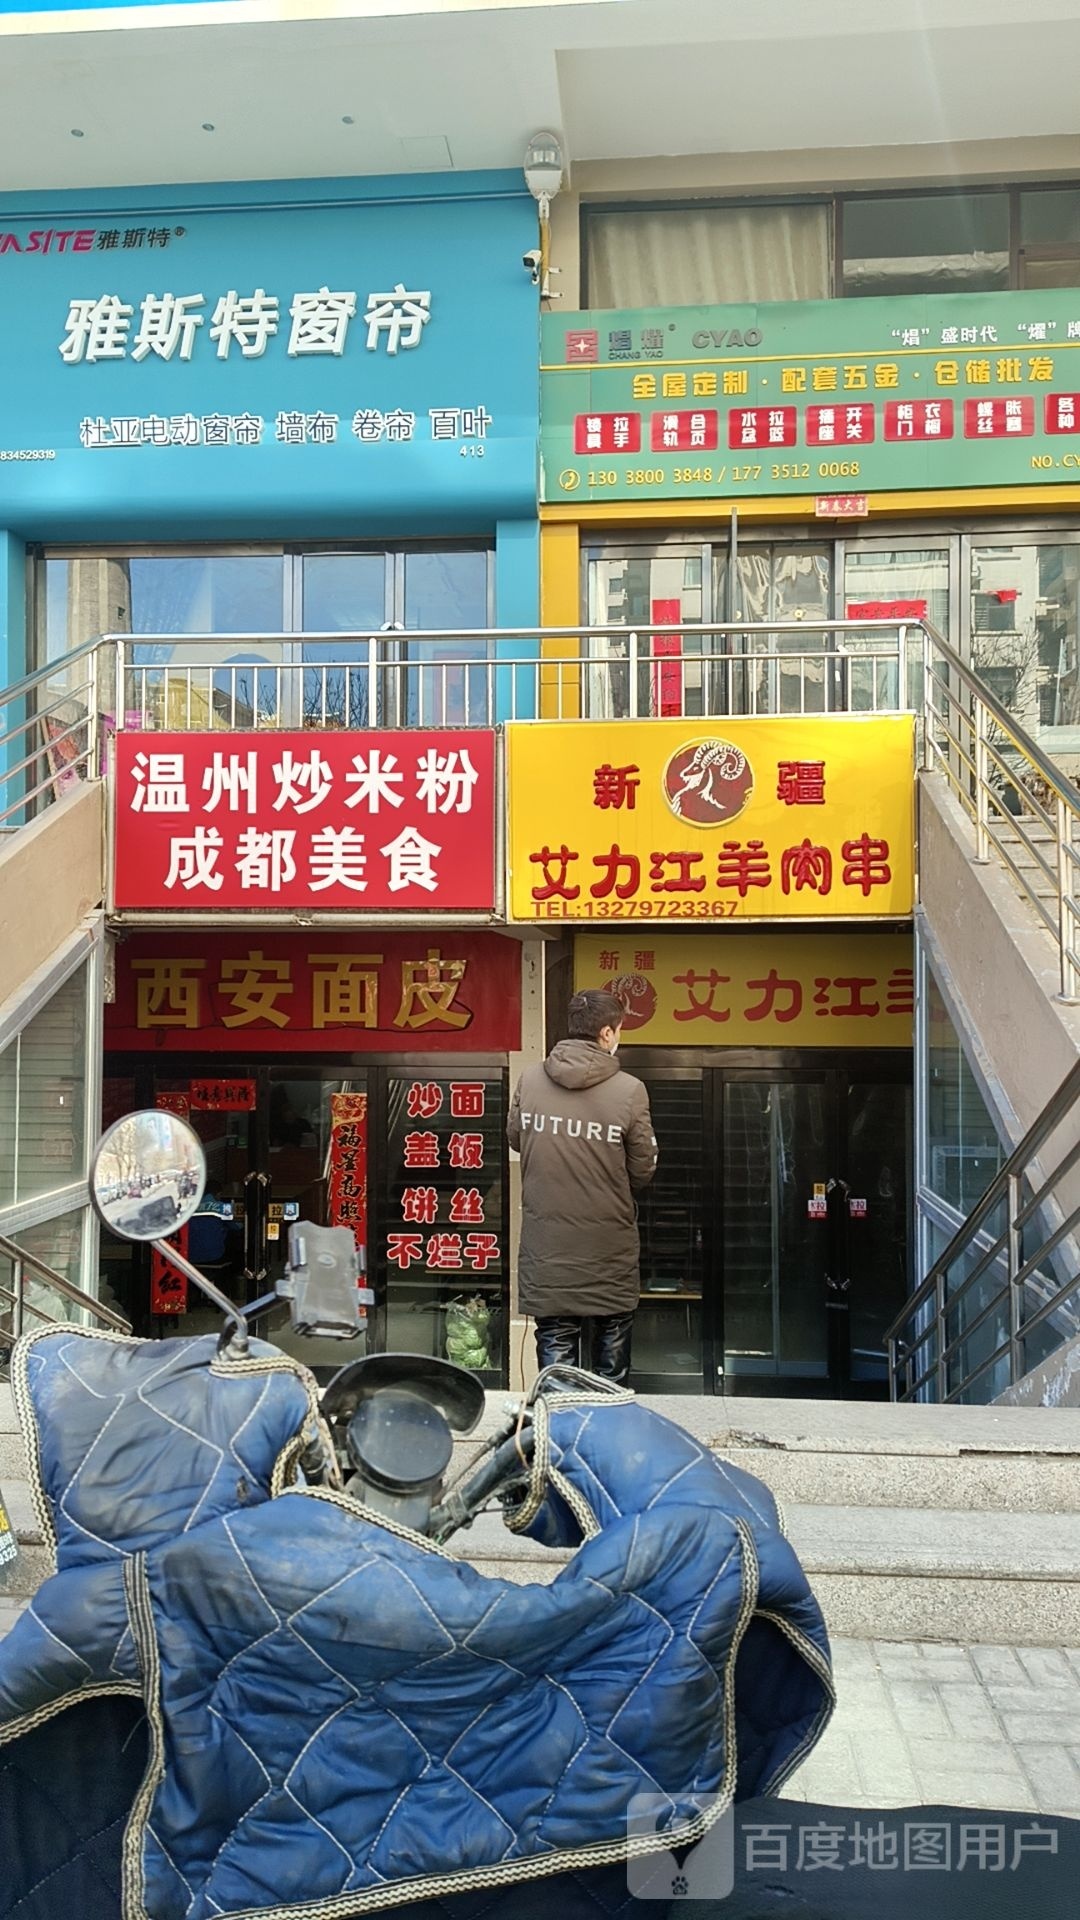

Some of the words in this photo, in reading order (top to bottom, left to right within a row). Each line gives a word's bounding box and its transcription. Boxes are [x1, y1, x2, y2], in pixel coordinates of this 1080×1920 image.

[0, 229, 97, 255] ASITE
[59, 283, 431, 364] 雅斯特窗帘
[692, 328, 763, 349] CYAO
[80, 412, 263, 447] 杜亚电动窗帘
[276, 410, 339, 444] 墙布
[352, 408, 416, 442] 卷帘
[429, 405, 493, 440] 百叶
[459, 445, 485, 457] 413
[587, 470, 617, 485] 130
[625, 469, 665, 485] 3800
[673, 468, 713, 483] 3848
[732, 465, 762, 482] 177
[771, 463, 811, 480] 3512
[819, 461, 861, 477] 0068
[130, 748, 479, 814] 温州炒米粉
[163, 825, 443, 893] 成都美食
[529, 832, 892, 900] 艾力江羊肉串
[598, 950, 656, 971] 新疆
[130, 948, 474, 1029] 西安面皮
[406, 1081, 486, 1118] 炒面
[520, 1112, 623, 1144] FUTURE
[404, 1131, 485, 1169] 盖饭
[336, 1123, 364, 1248] 福星高照
[401, 1187, 486, 1224] 饼丝
[387, 1233, 501, 1270] 不烂子
